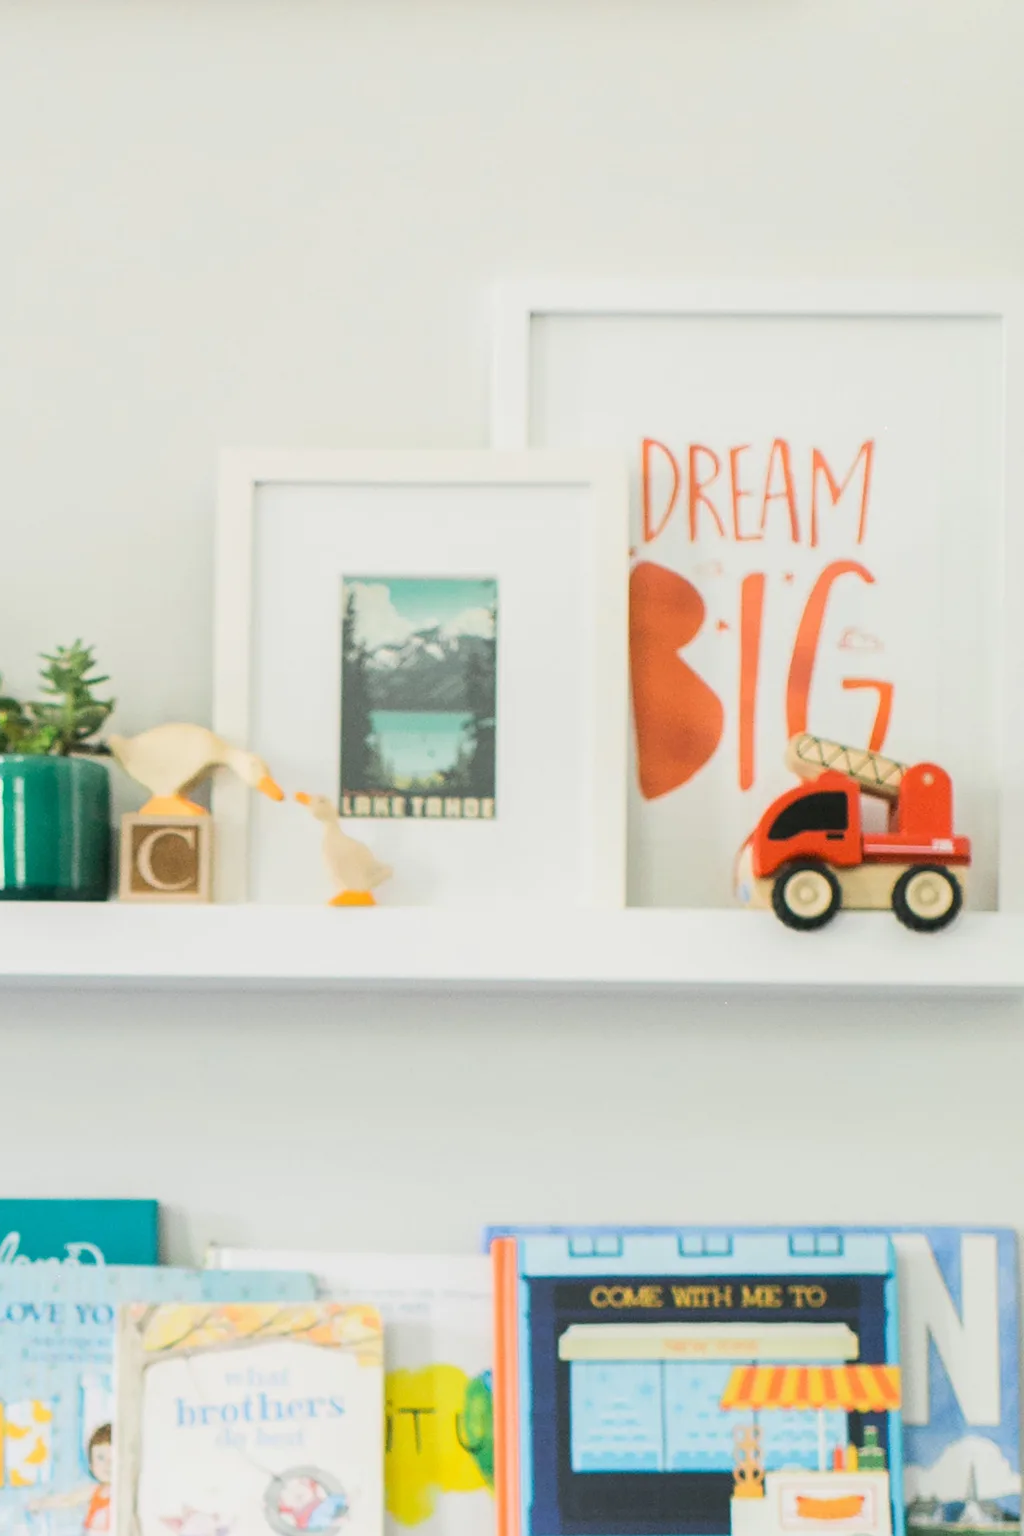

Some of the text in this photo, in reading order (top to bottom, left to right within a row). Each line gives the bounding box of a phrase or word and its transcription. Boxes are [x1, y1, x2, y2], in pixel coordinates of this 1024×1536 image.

[641, 437, 876, 548] DREAM
[629, 559, 894, 801] BIG
[135, 829, 197, 892] C
[75, 1302, 114, 1326] YO
[590, 1285, 828, 1308] COME WITH ME TO
[176, 1392, 346, 1428] brothers
